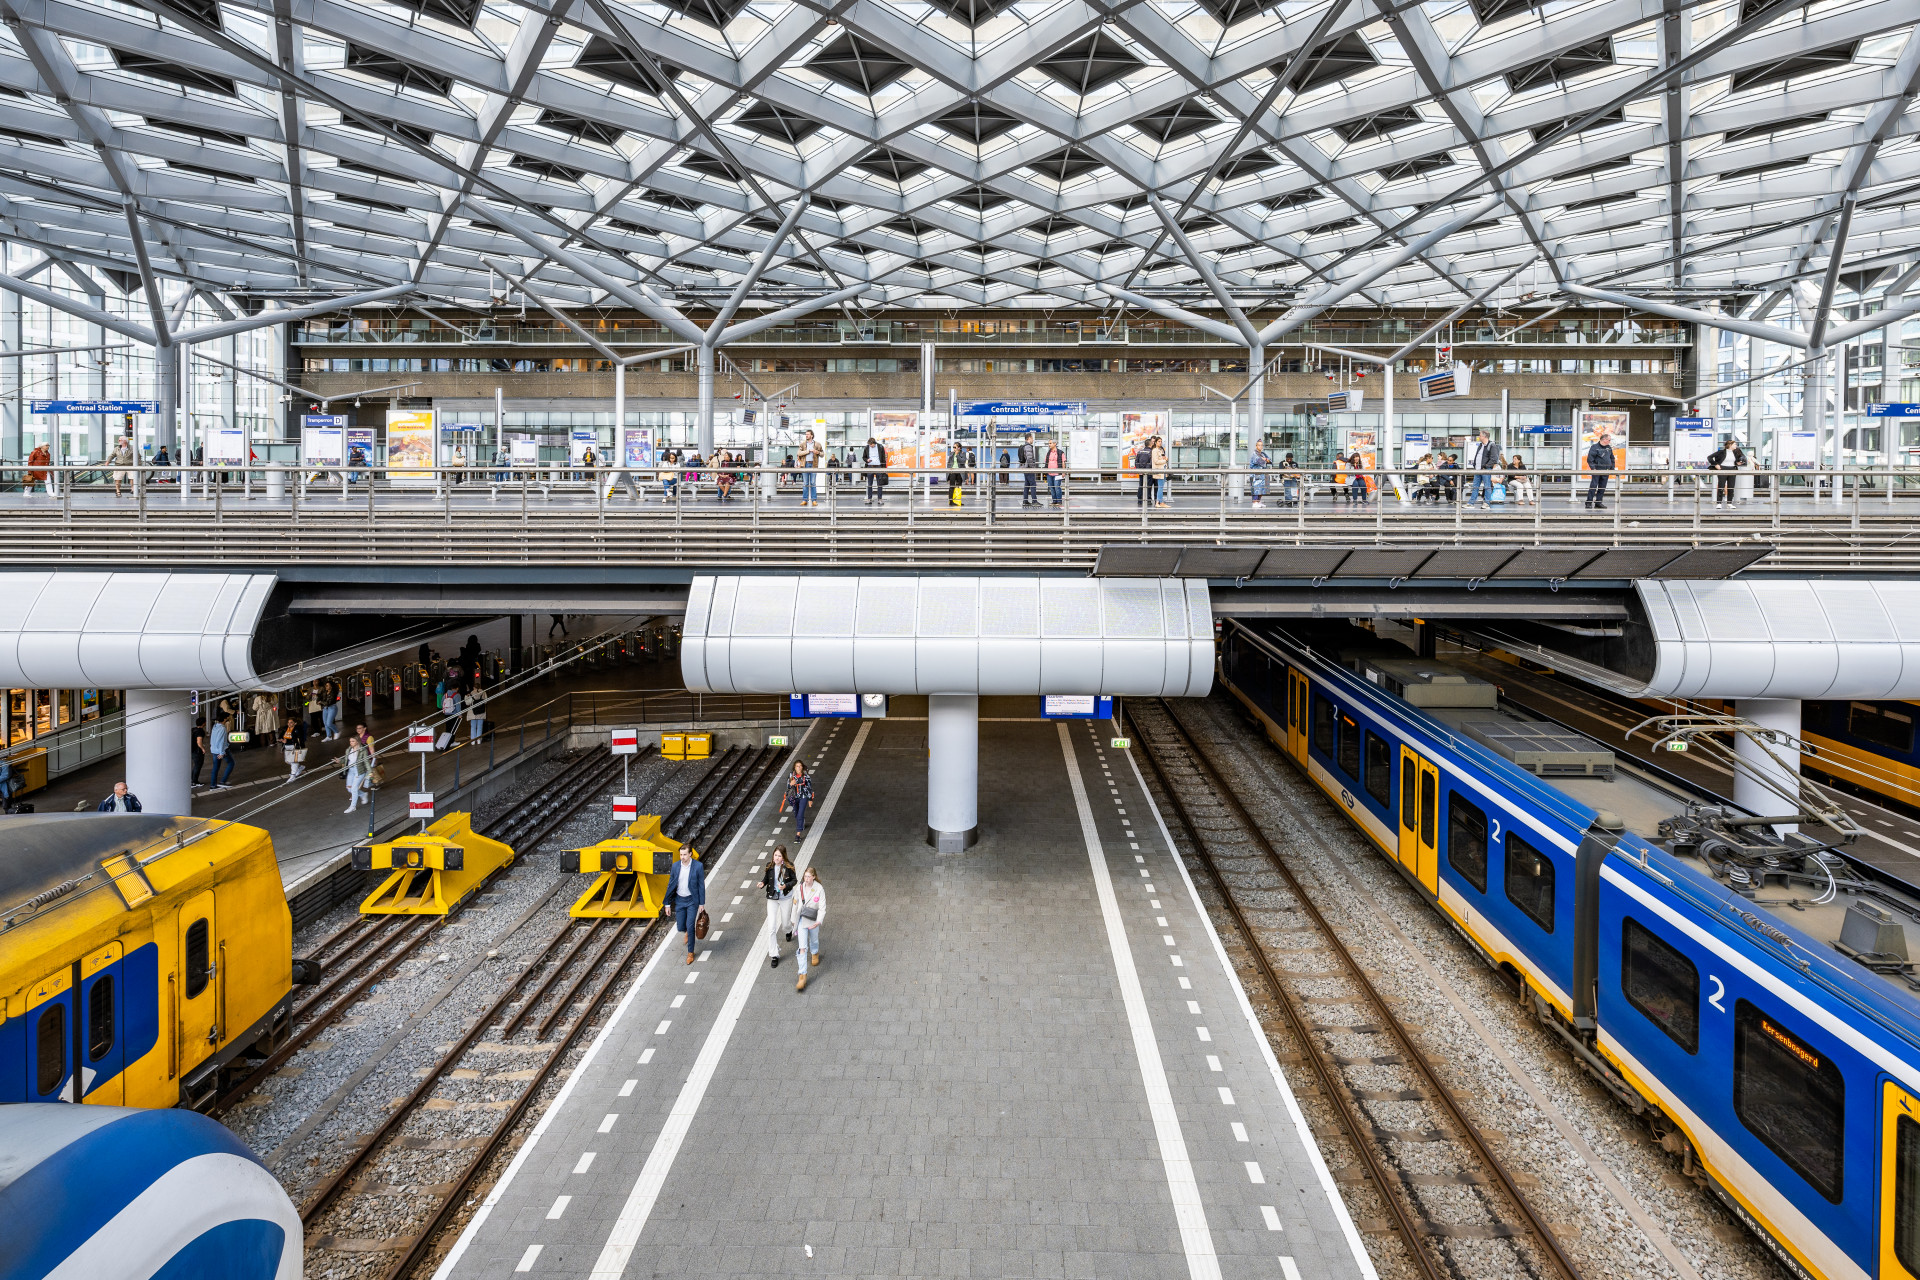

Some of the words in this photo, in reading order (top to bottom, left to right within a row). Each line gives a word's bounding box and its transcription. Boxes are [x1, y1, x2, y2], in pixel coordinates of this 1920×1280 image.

[1333, 704, 1338, 720] 2
[1491, 818, 1501, 844] 2
[1708, 974, 1726, 1014] 2
[1762, 1020, 1818, 1068] Kersenboogerd
[1736, 1206, 1756, 1231] NL-NS
